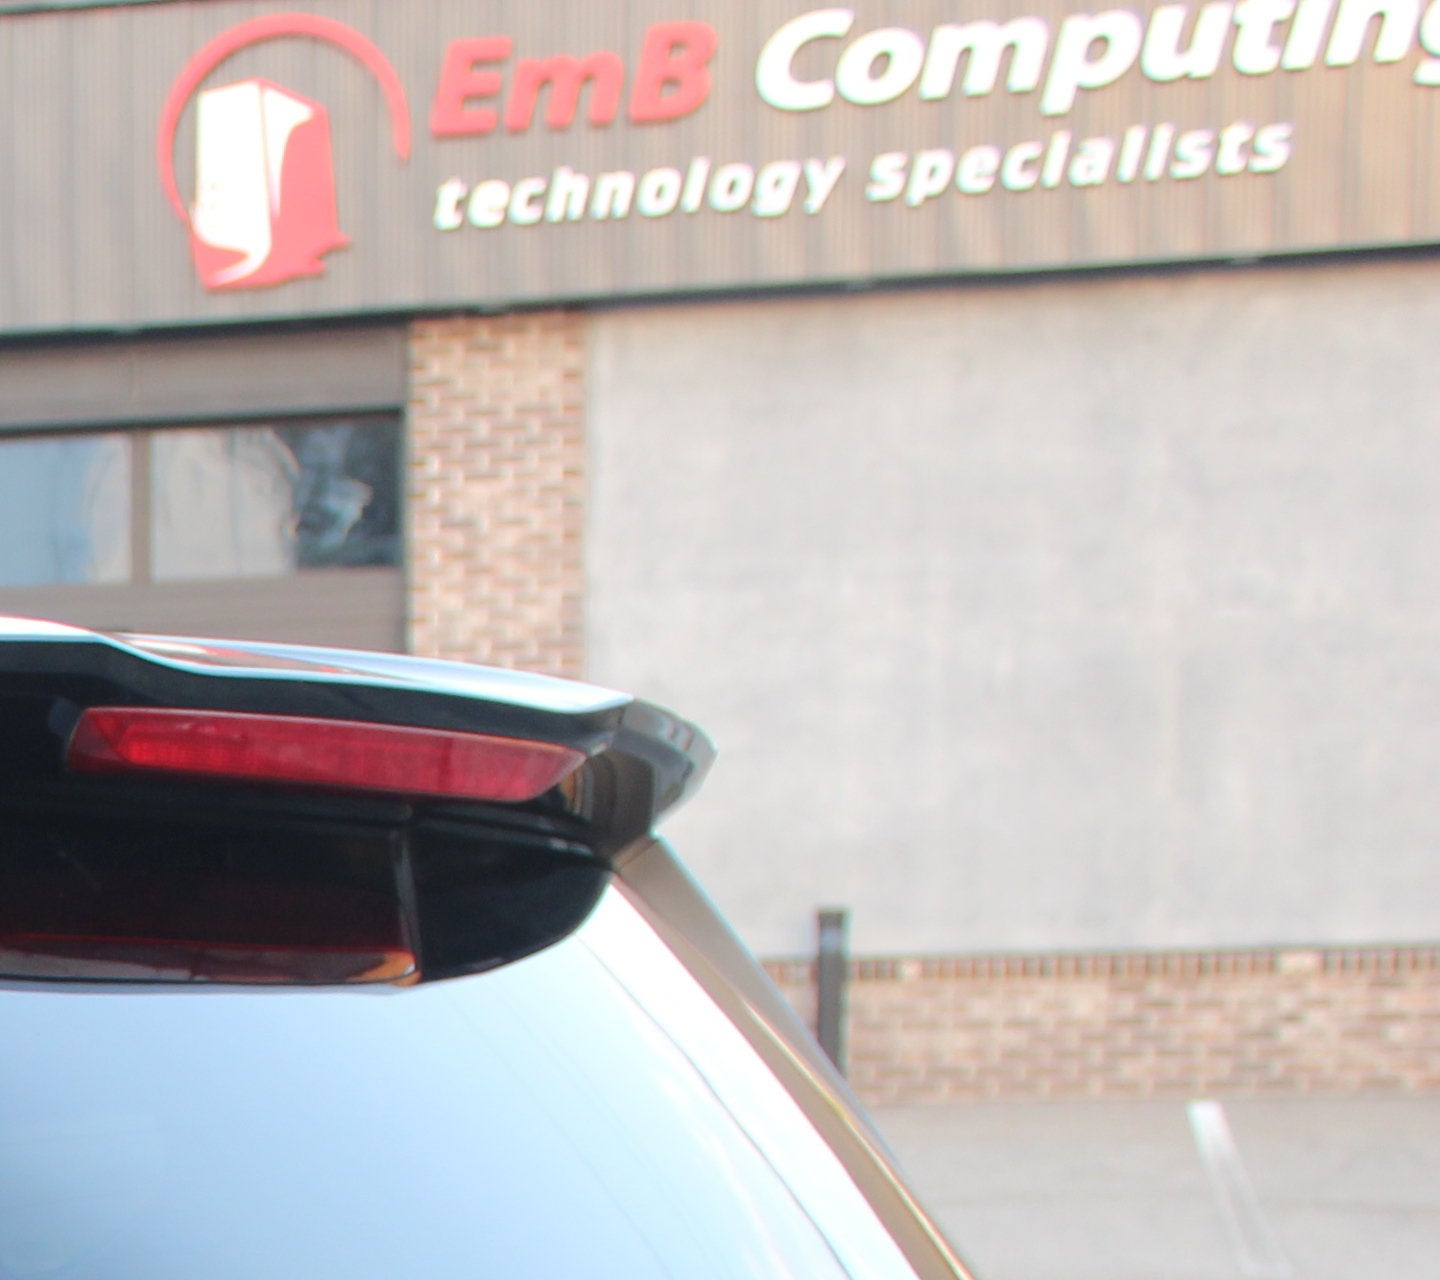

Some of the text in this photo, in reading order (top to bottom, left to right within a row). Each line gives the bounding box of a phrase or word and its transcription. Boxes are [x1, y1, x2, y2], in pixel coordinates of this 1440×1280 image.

[430, 20, 719, 138] EmB
[433, 121, 1295, 230] technology specialists
